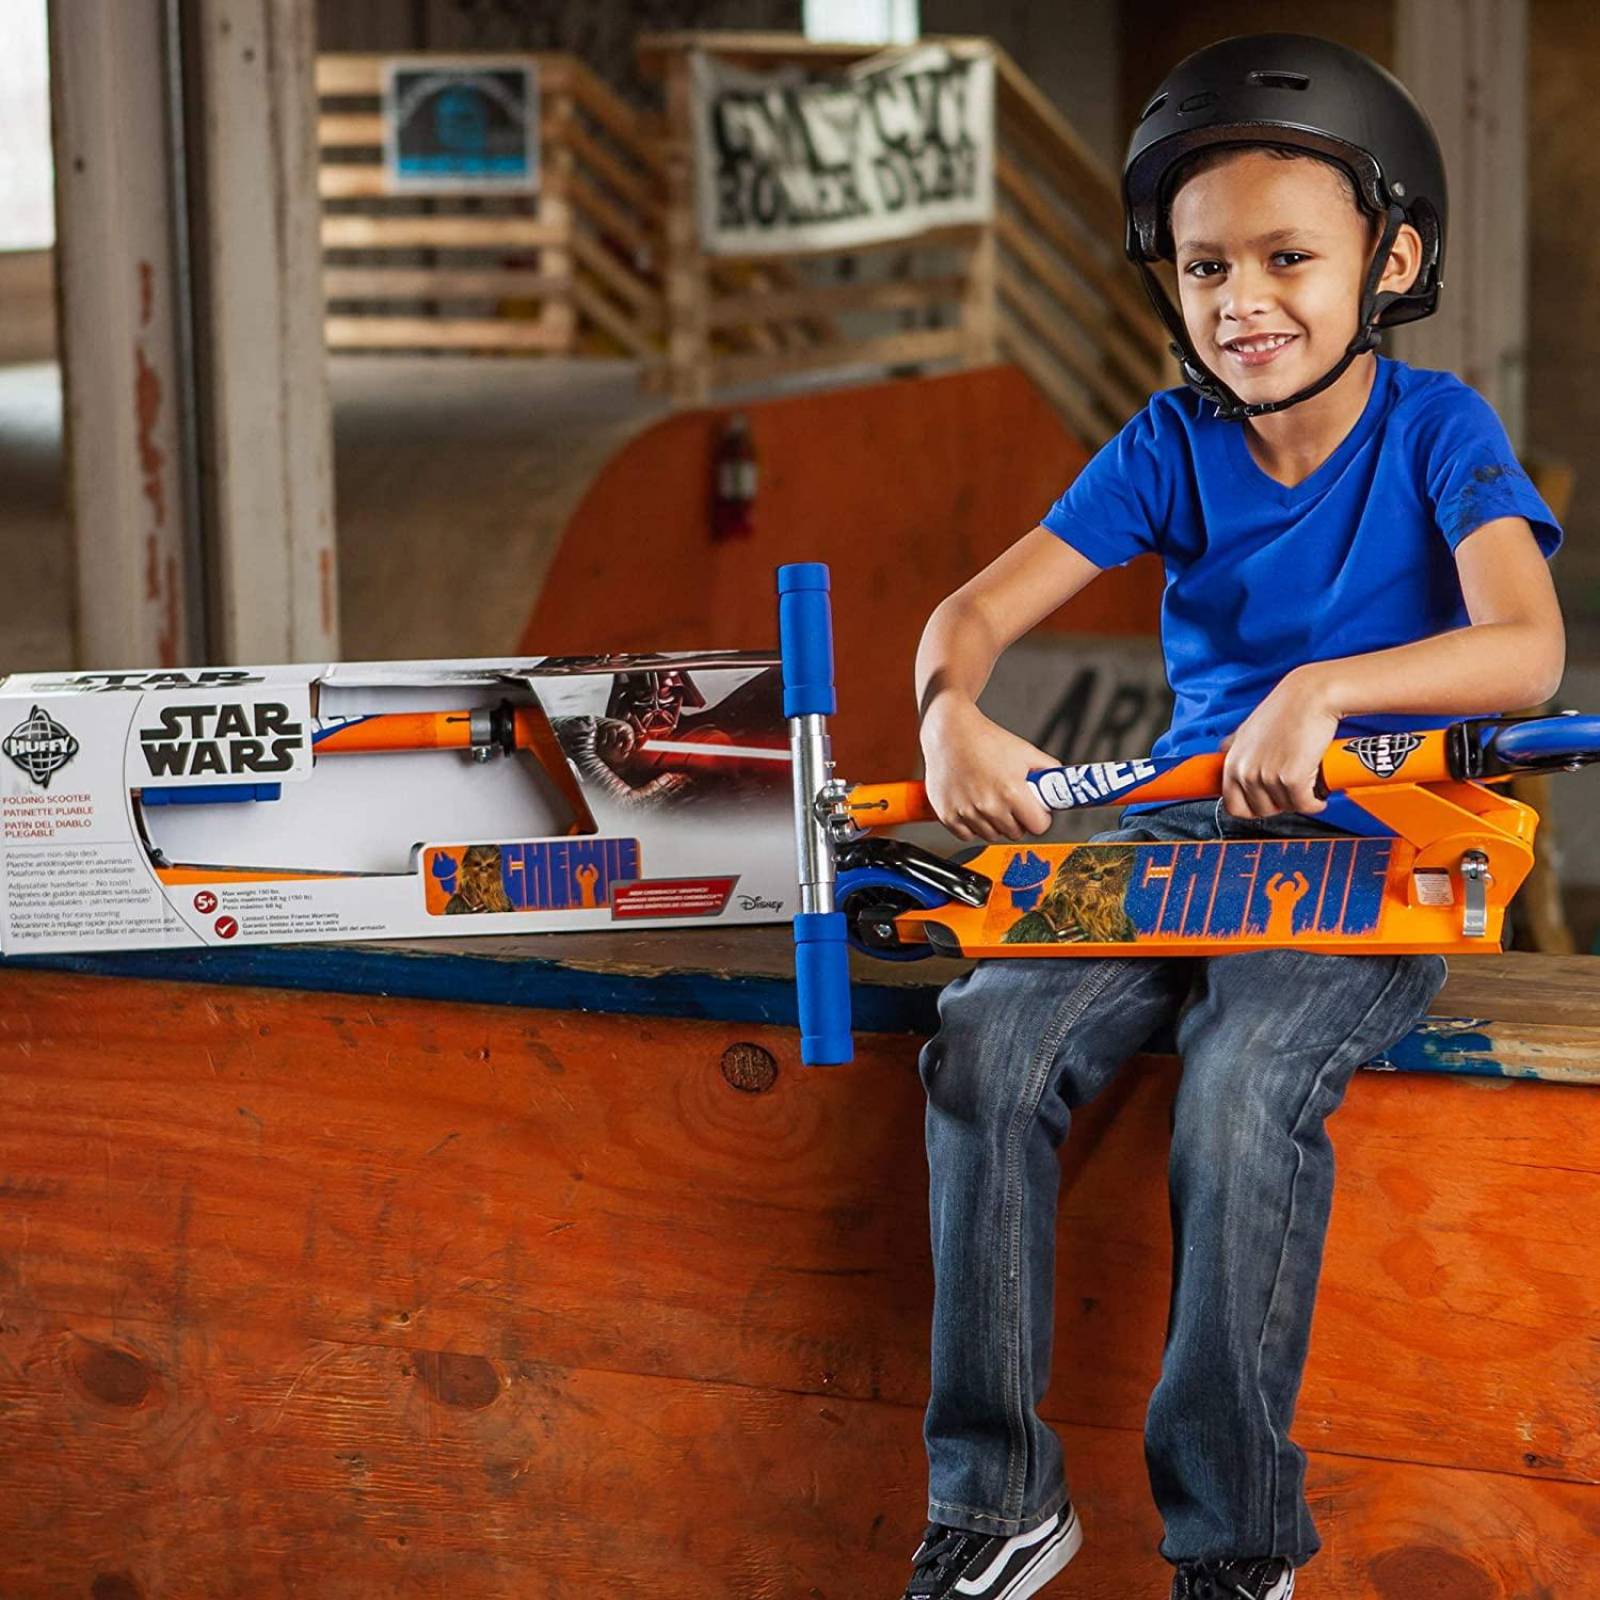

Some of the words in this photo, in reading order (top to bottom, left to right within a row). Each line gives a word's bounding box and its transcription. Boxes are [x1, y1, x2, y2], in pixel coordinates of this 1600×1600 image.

[140, 702, 302, 741] STAR
[1038, 666, 1172, 762] AR
[11, 736, 70, 757] HUFFY
[141, 737, 302, 777] WARS
[2, 796, 45, 805] FOLDING
[47, 794, 91, 804] SCOOTER
[3, 808, 53, 817] PATINETTE
[56, 806, 93, 816] PLIABLE
[34, 821, 53, 829] DEL
[56, 818, 92, 828] DIABLO
[5, 829, 54, 838] PLEGABLE
[1124, 840, 1392, 935] CHEWIE
[197, 895, 216, 910] 5+
